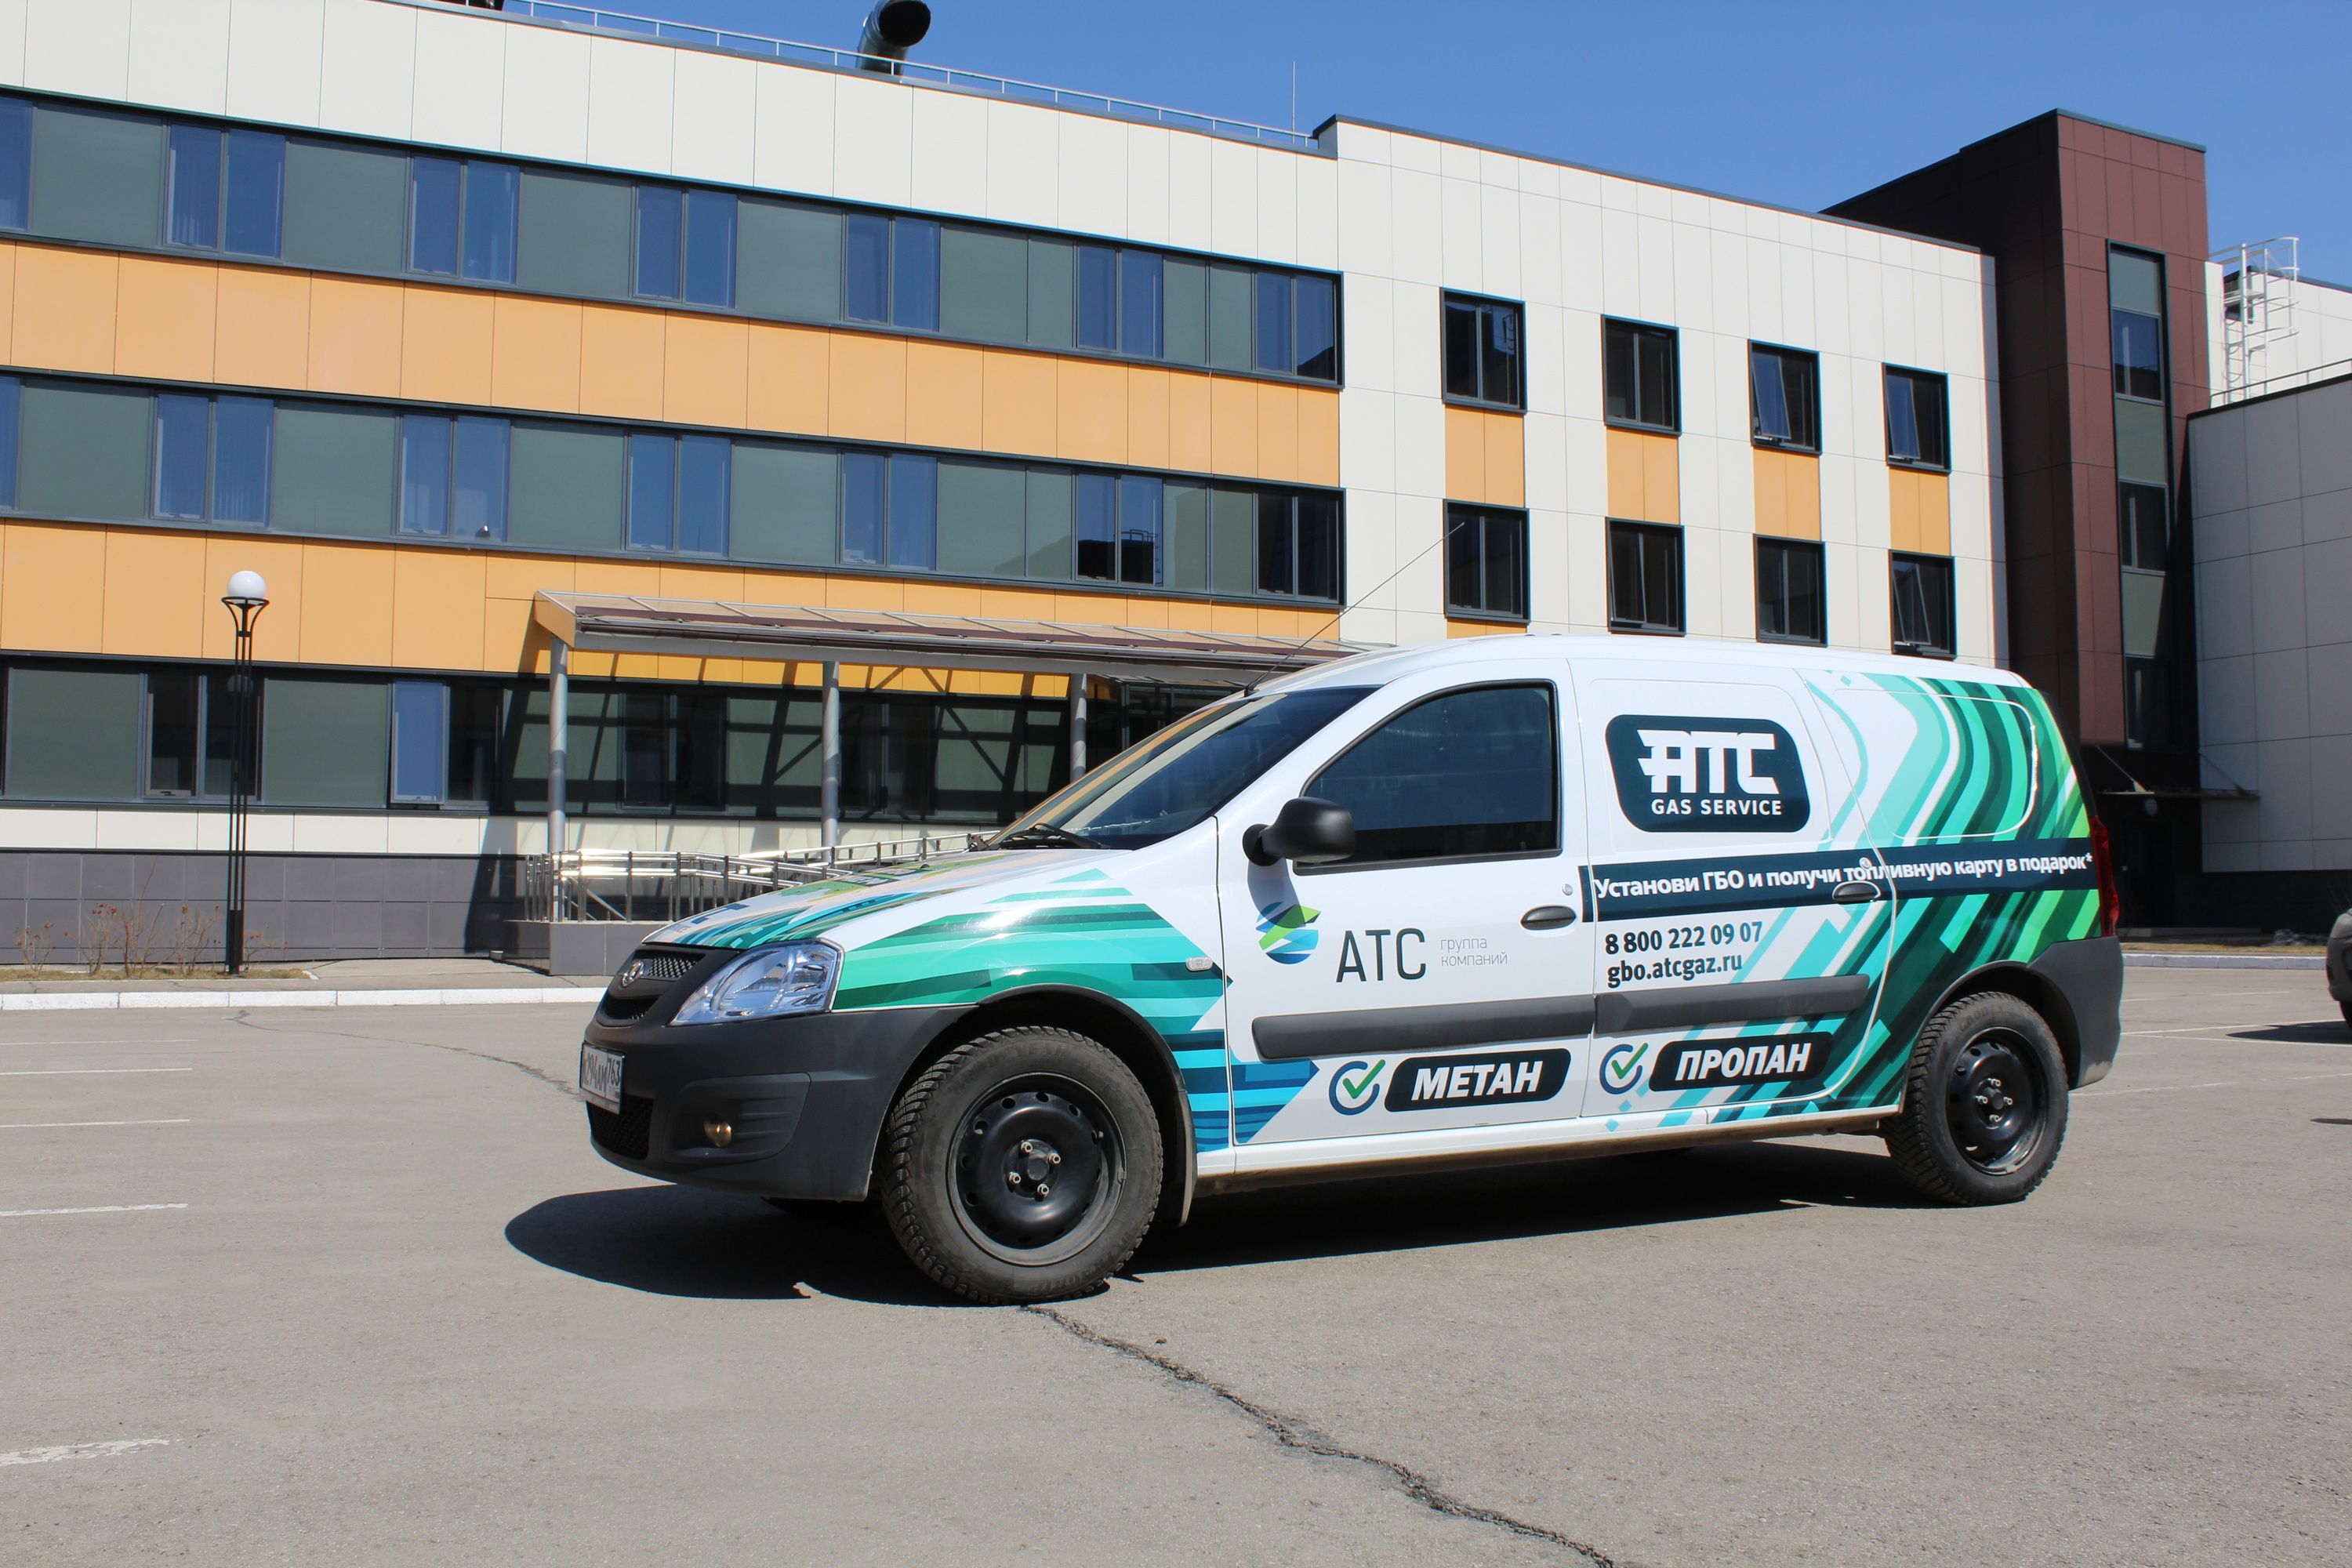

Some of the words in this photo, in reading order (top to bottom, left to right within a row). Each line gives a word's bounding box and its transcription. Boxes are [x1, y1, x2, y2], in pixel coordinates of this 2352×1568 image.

[1651, 799, 1692, 815] GAS
[1700, 799, 1782, 815] SERVICE
[1592, 877, 1700, 898] Установи
[1702, 869, 1744, 891] ГБО
[1748, 873, 1763, 887] и
[1766, 867, 1842, 889] получи
[1843, 860, 1950, 882] топливную
[1955, 858, 2003, 878] карту
[2005, 856, 2017, 873] в
[1336, 927, 1427, 983] АТС
[1440, 937, 1488, 953] группа
[1605, 934, 1619, 955] 8
[1624, 930, 1662, 953] 800
[1668, 926, 1706, 949] 222
[1710, 923, 1735, 945] 09
[1739, 921, 1763, 942] 07
[1441, 951, 1508, 967] компаний
[1607, 954, 1743, 989] gbo.atcgaz.ru
[1675, 1043, 1813, 1082] ПРОПАН
[1411, 1060, 1544, 1102] МЕТАН
